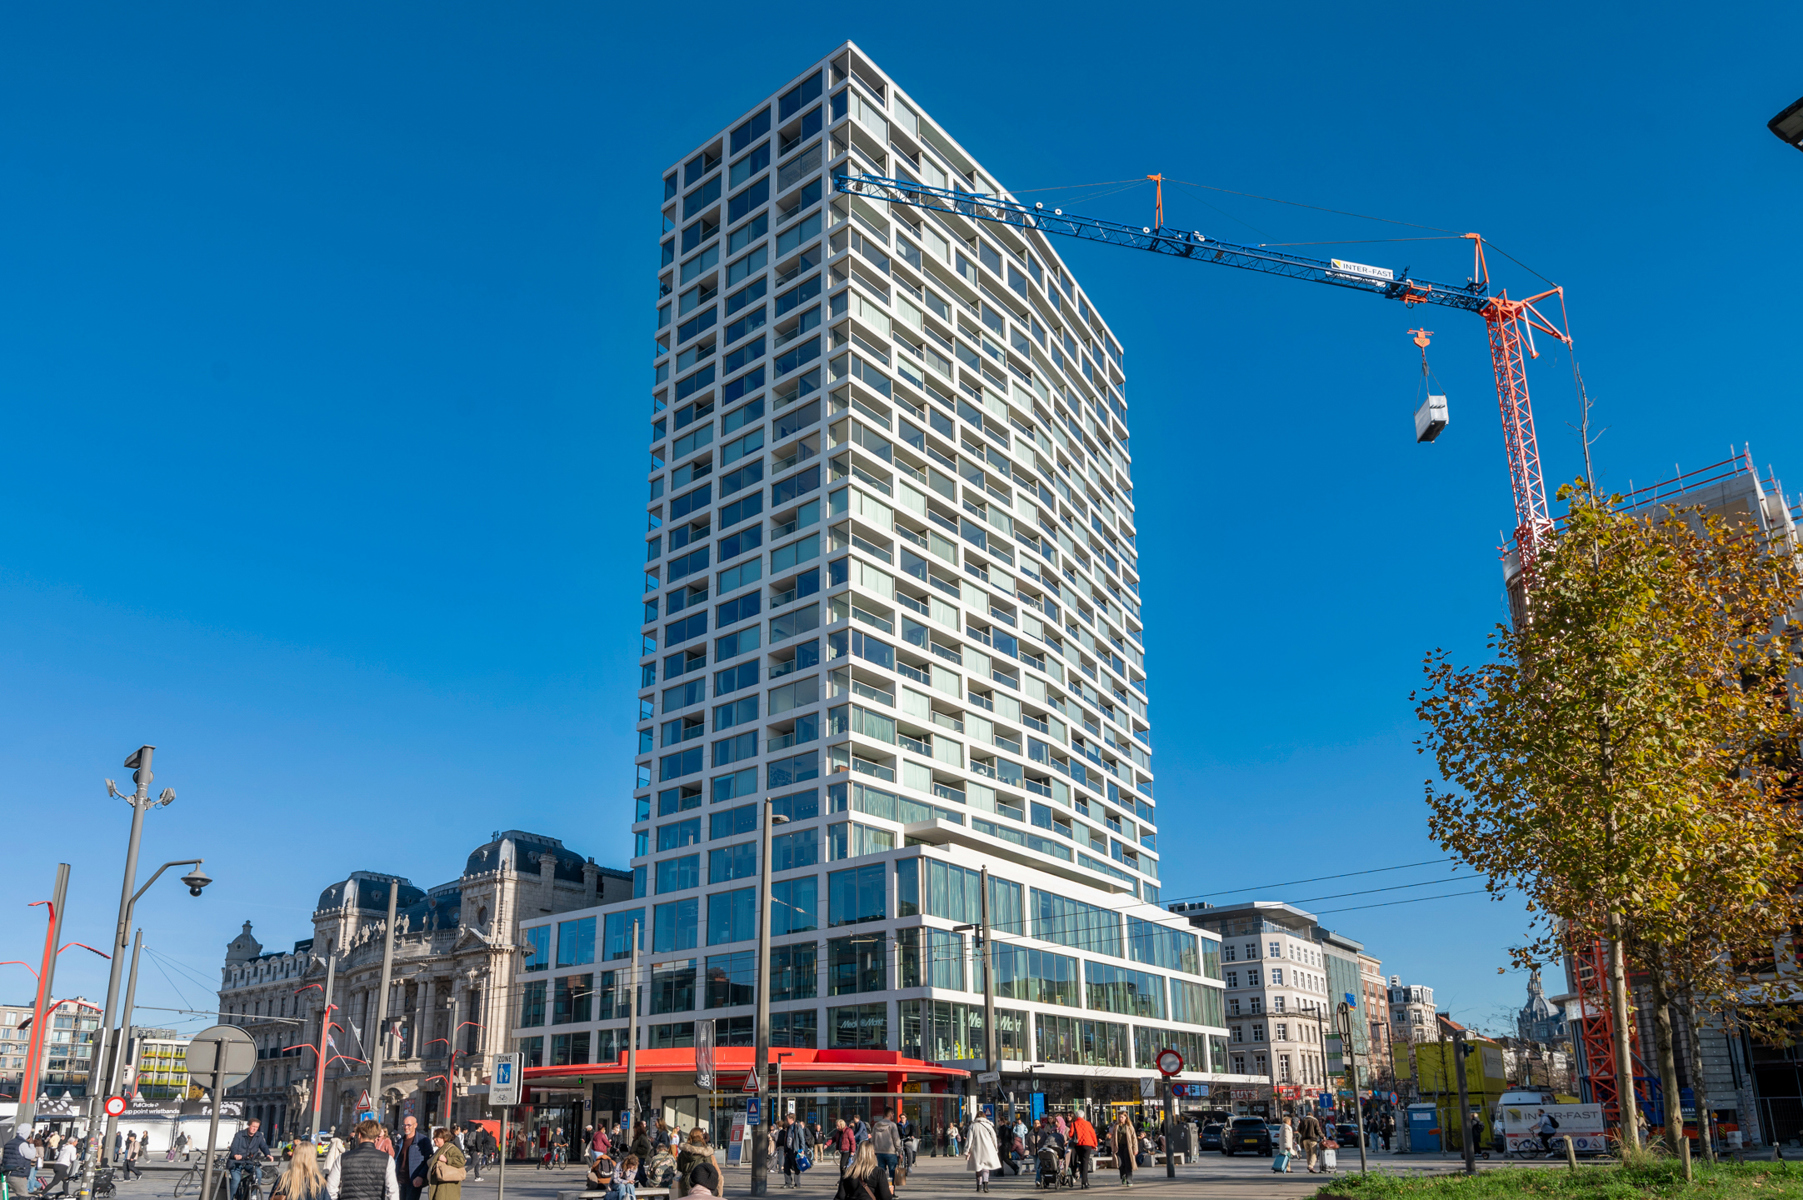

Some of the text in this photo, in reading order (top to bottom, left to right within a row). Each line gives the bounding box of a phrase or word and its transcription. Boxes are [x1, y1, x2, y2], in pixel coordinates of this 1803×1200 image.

[1343, 263, 1392, 277] INTER-FAST
[498, 1055, 513, 1063] ZONE
[1230, 1090, 1258, 1099] GUYS
[1525, 1111, 1598, 1120] INR-FAST
